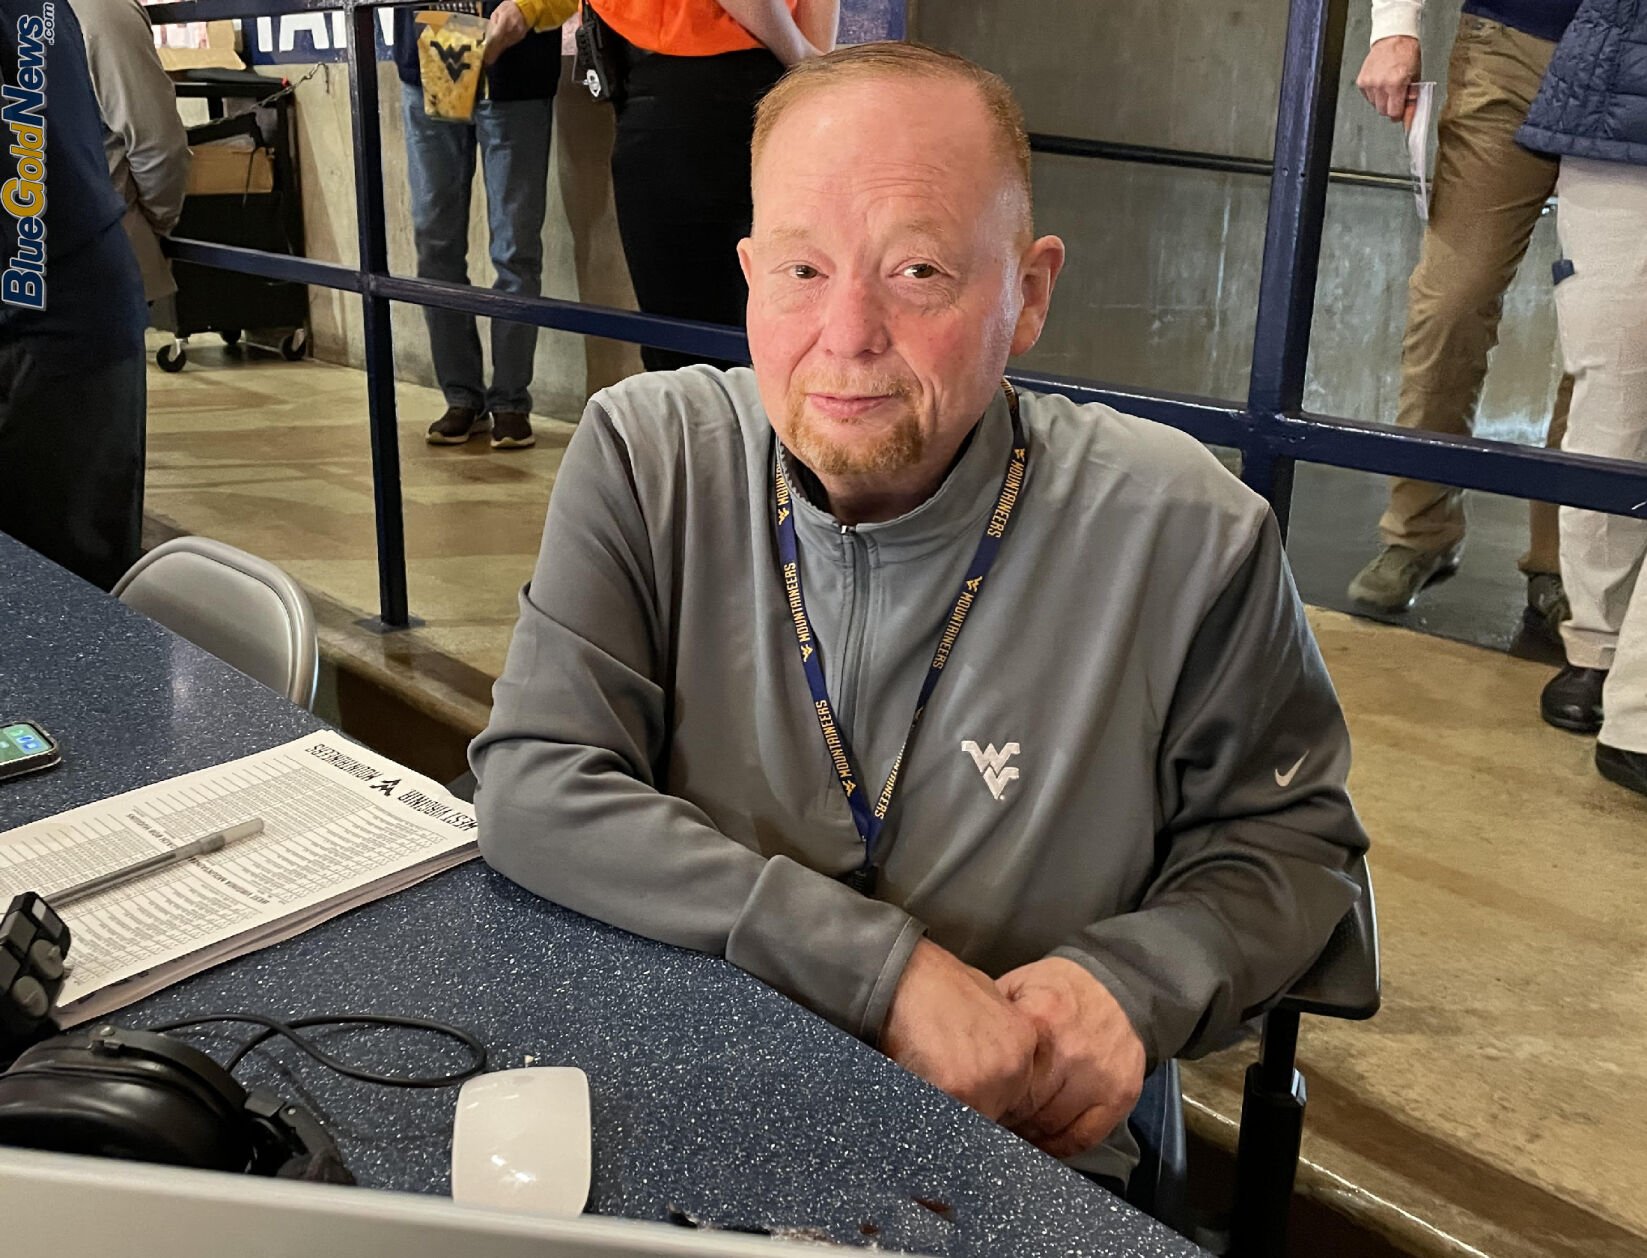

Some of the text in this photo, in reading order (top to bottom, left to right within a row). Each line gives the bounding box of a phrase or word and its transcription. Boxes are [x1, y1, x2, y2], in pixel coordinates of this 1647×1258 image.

[986, 459, 1025, 538] MOUNTAINEERS
[784, 562, 811, 643] MOUNTAINEERS
[932, 590, 974, 670] MOUNTAINEERS
[815, 699, 853, 778] MOUNTAINEERS
